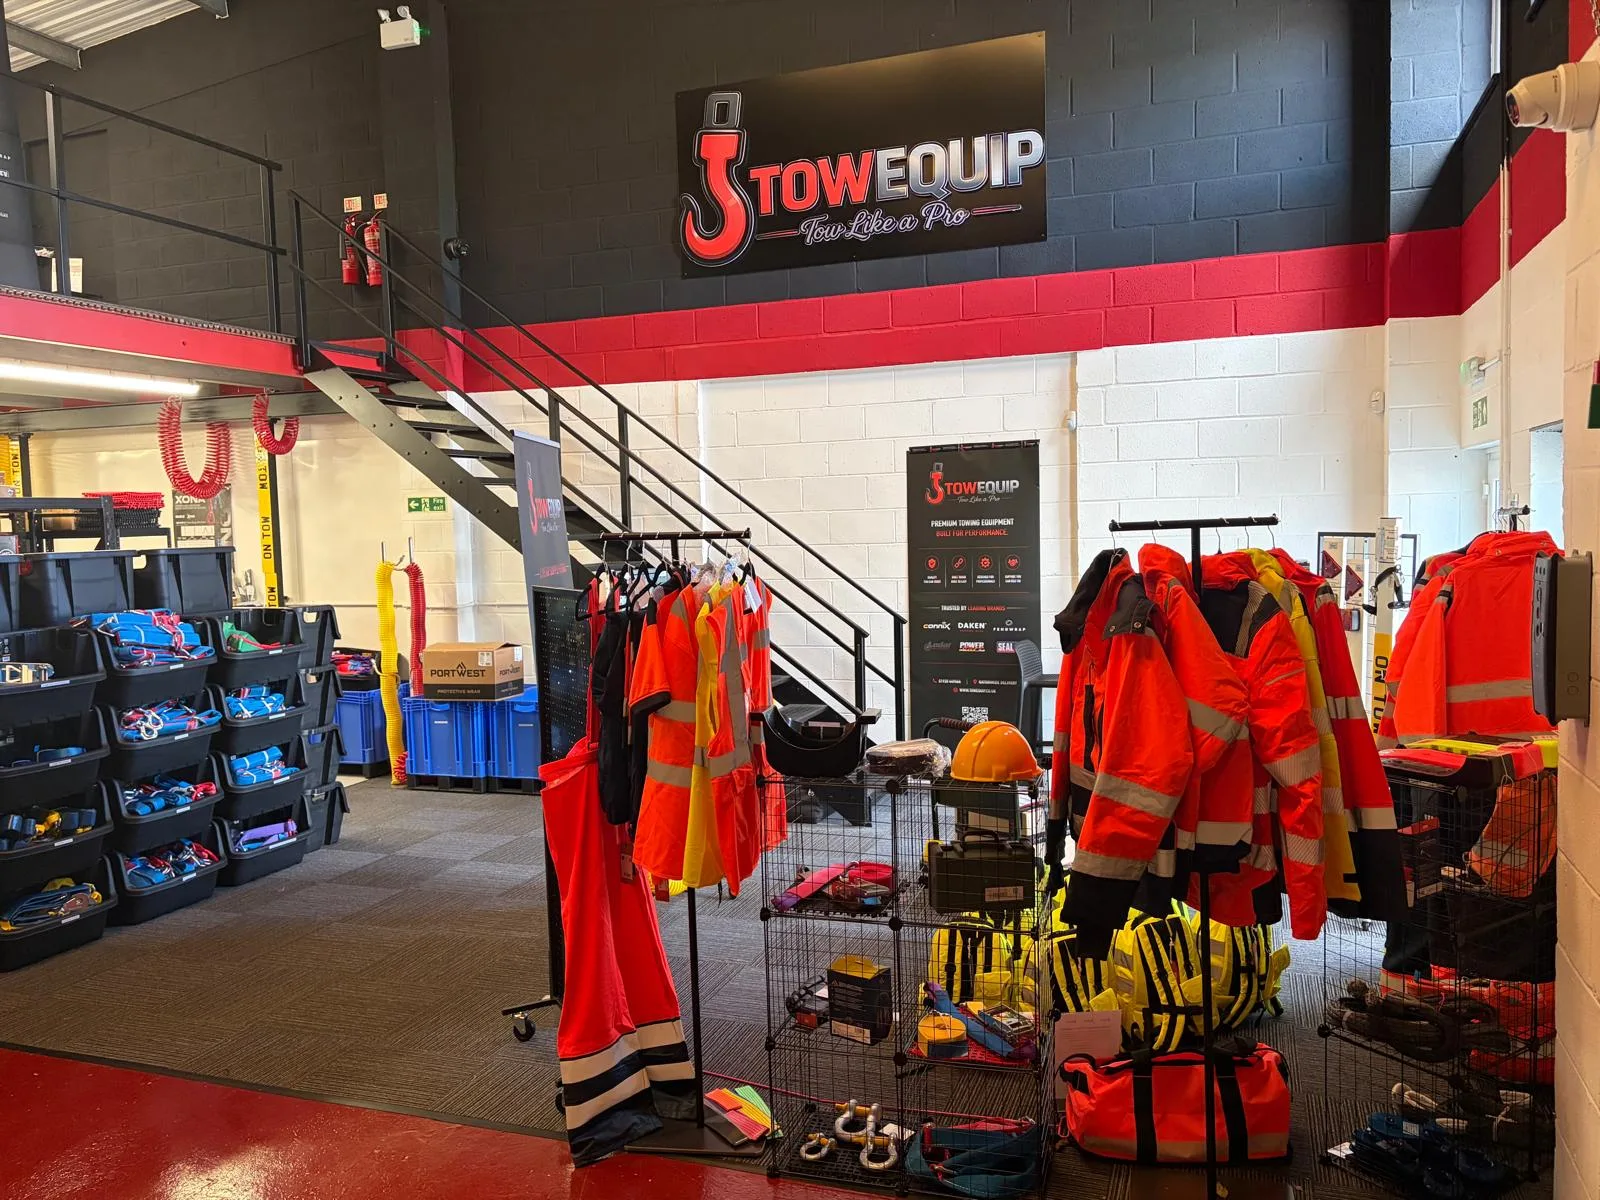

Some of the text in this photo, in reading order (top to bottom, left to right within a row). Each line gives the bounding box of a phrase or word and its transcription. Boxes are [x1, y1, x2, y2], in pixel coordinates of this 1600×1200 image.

[748, 128, 1045, 216] TOWEQUIP
[800, 200, 970, 246] Tow Like a Pro
[12, 454, 20, 476] TOW
[945, 479, 1020, 496] TOWEQUIP
[931, 519, 957, 527] PREMIUM
[981, 517, 1014, 526] EQUIPMENT
[261, 516, 272, 560] ON TOW
[959, 641, 985, 649] POWER
[430, 668, 486, 678] PORTWEST
[1374, 655, 1389, 683] ON
